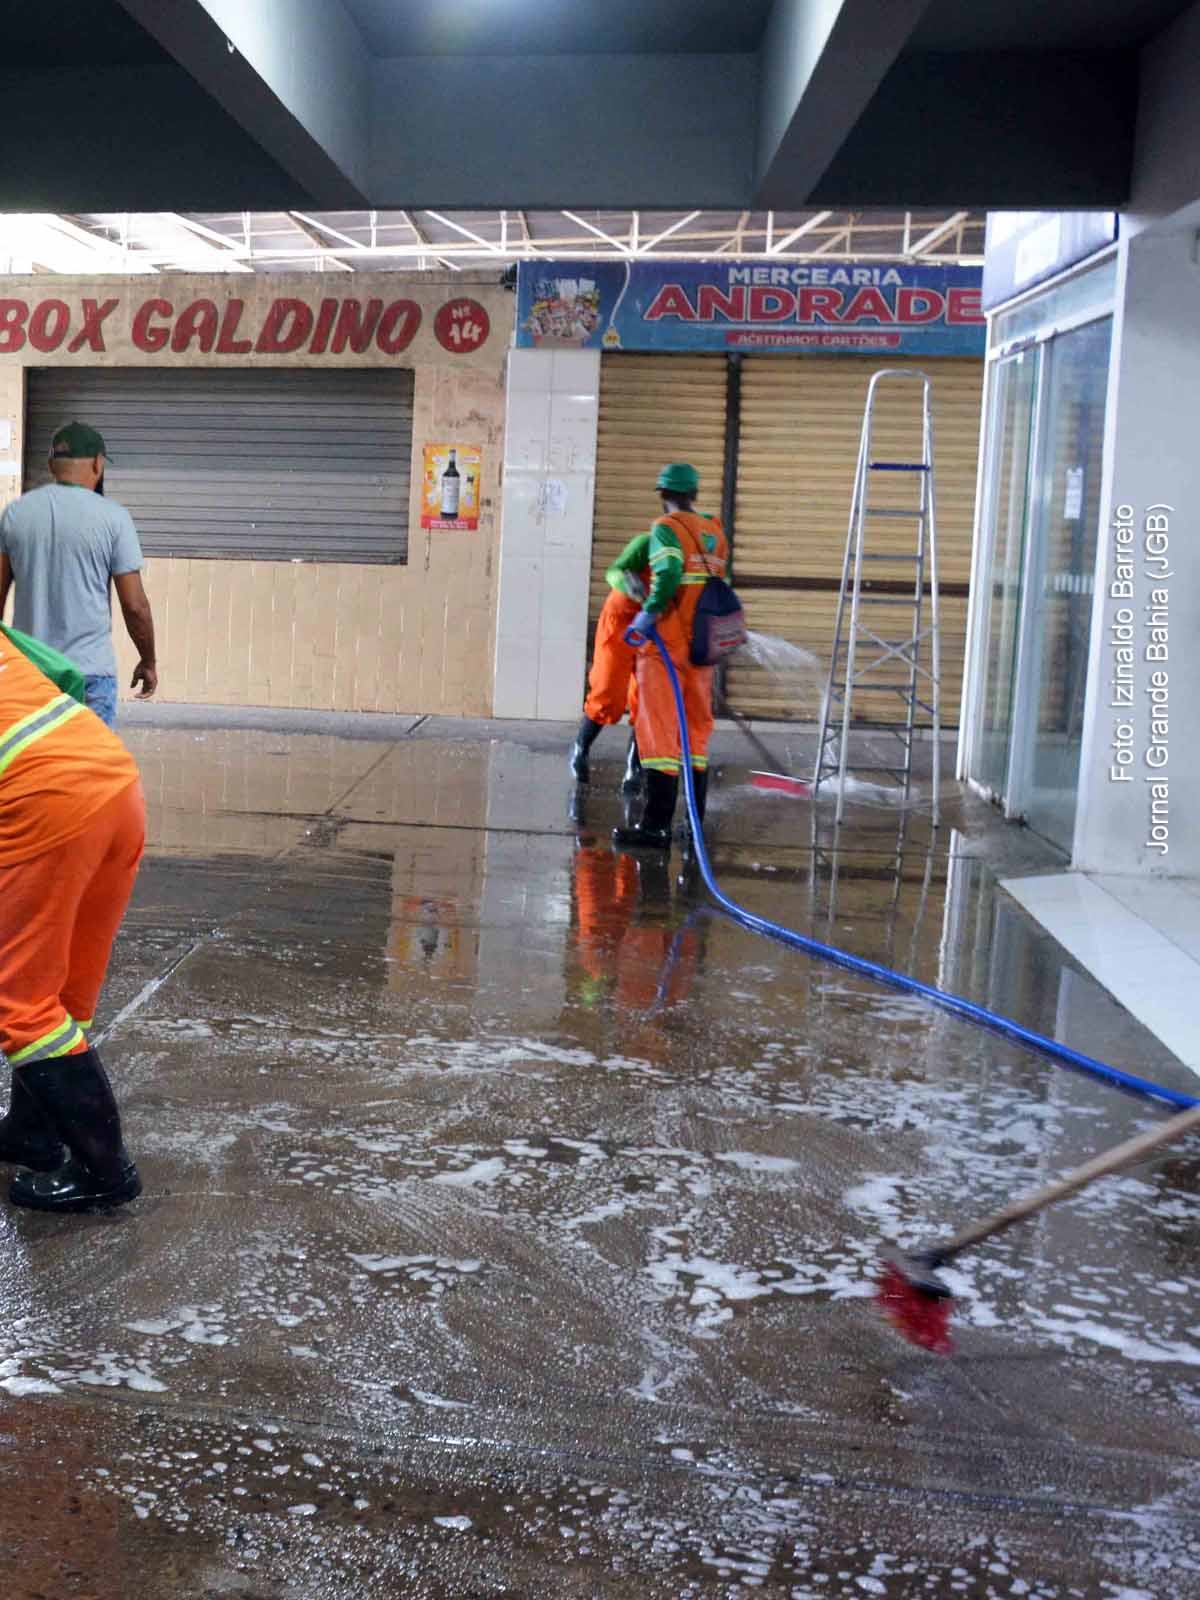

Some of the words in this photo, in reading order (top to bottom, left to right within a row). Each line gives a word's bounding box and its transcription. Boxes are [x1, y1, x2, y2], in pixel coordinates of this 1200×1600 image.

[728, 268, 903, 285] MERCEARIA
[643, 283, 984, 325] ANDRADE
[132, 298, 422, 354] GALDINO
[449, 320, 482, 344] 14
[736, 332, 818, 346] ACEITAMOS
[822, 332, 888, 347] CARTÕES
